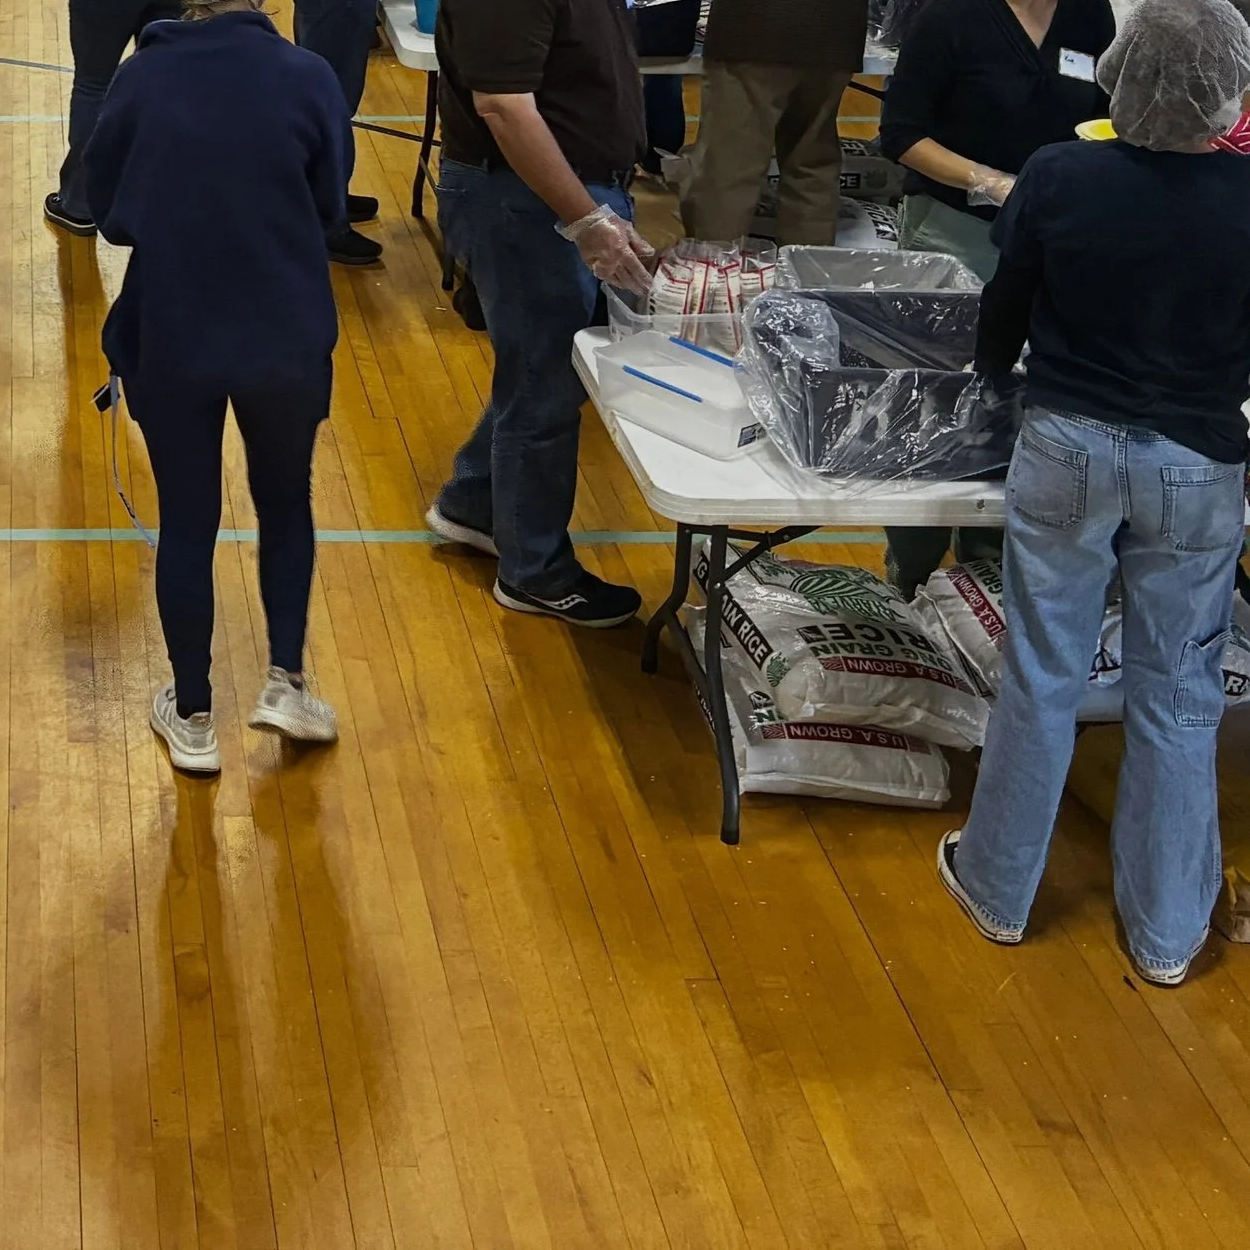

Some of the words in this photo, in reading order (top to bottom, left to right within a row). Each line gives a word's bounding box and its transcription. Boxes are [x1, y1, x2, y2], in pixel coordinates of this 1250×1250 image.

[737, 621, 768, 663] RICE
[822, 623, 937, 654] RICE
[809, 641, 894, 658] GRAIN
[847, 659, 907, 675] GROWN
[899, 647, 952, 671] ONG
[790, 725, 852, 740] GROWN
[863, 730, 904, 748] U.S.A.
